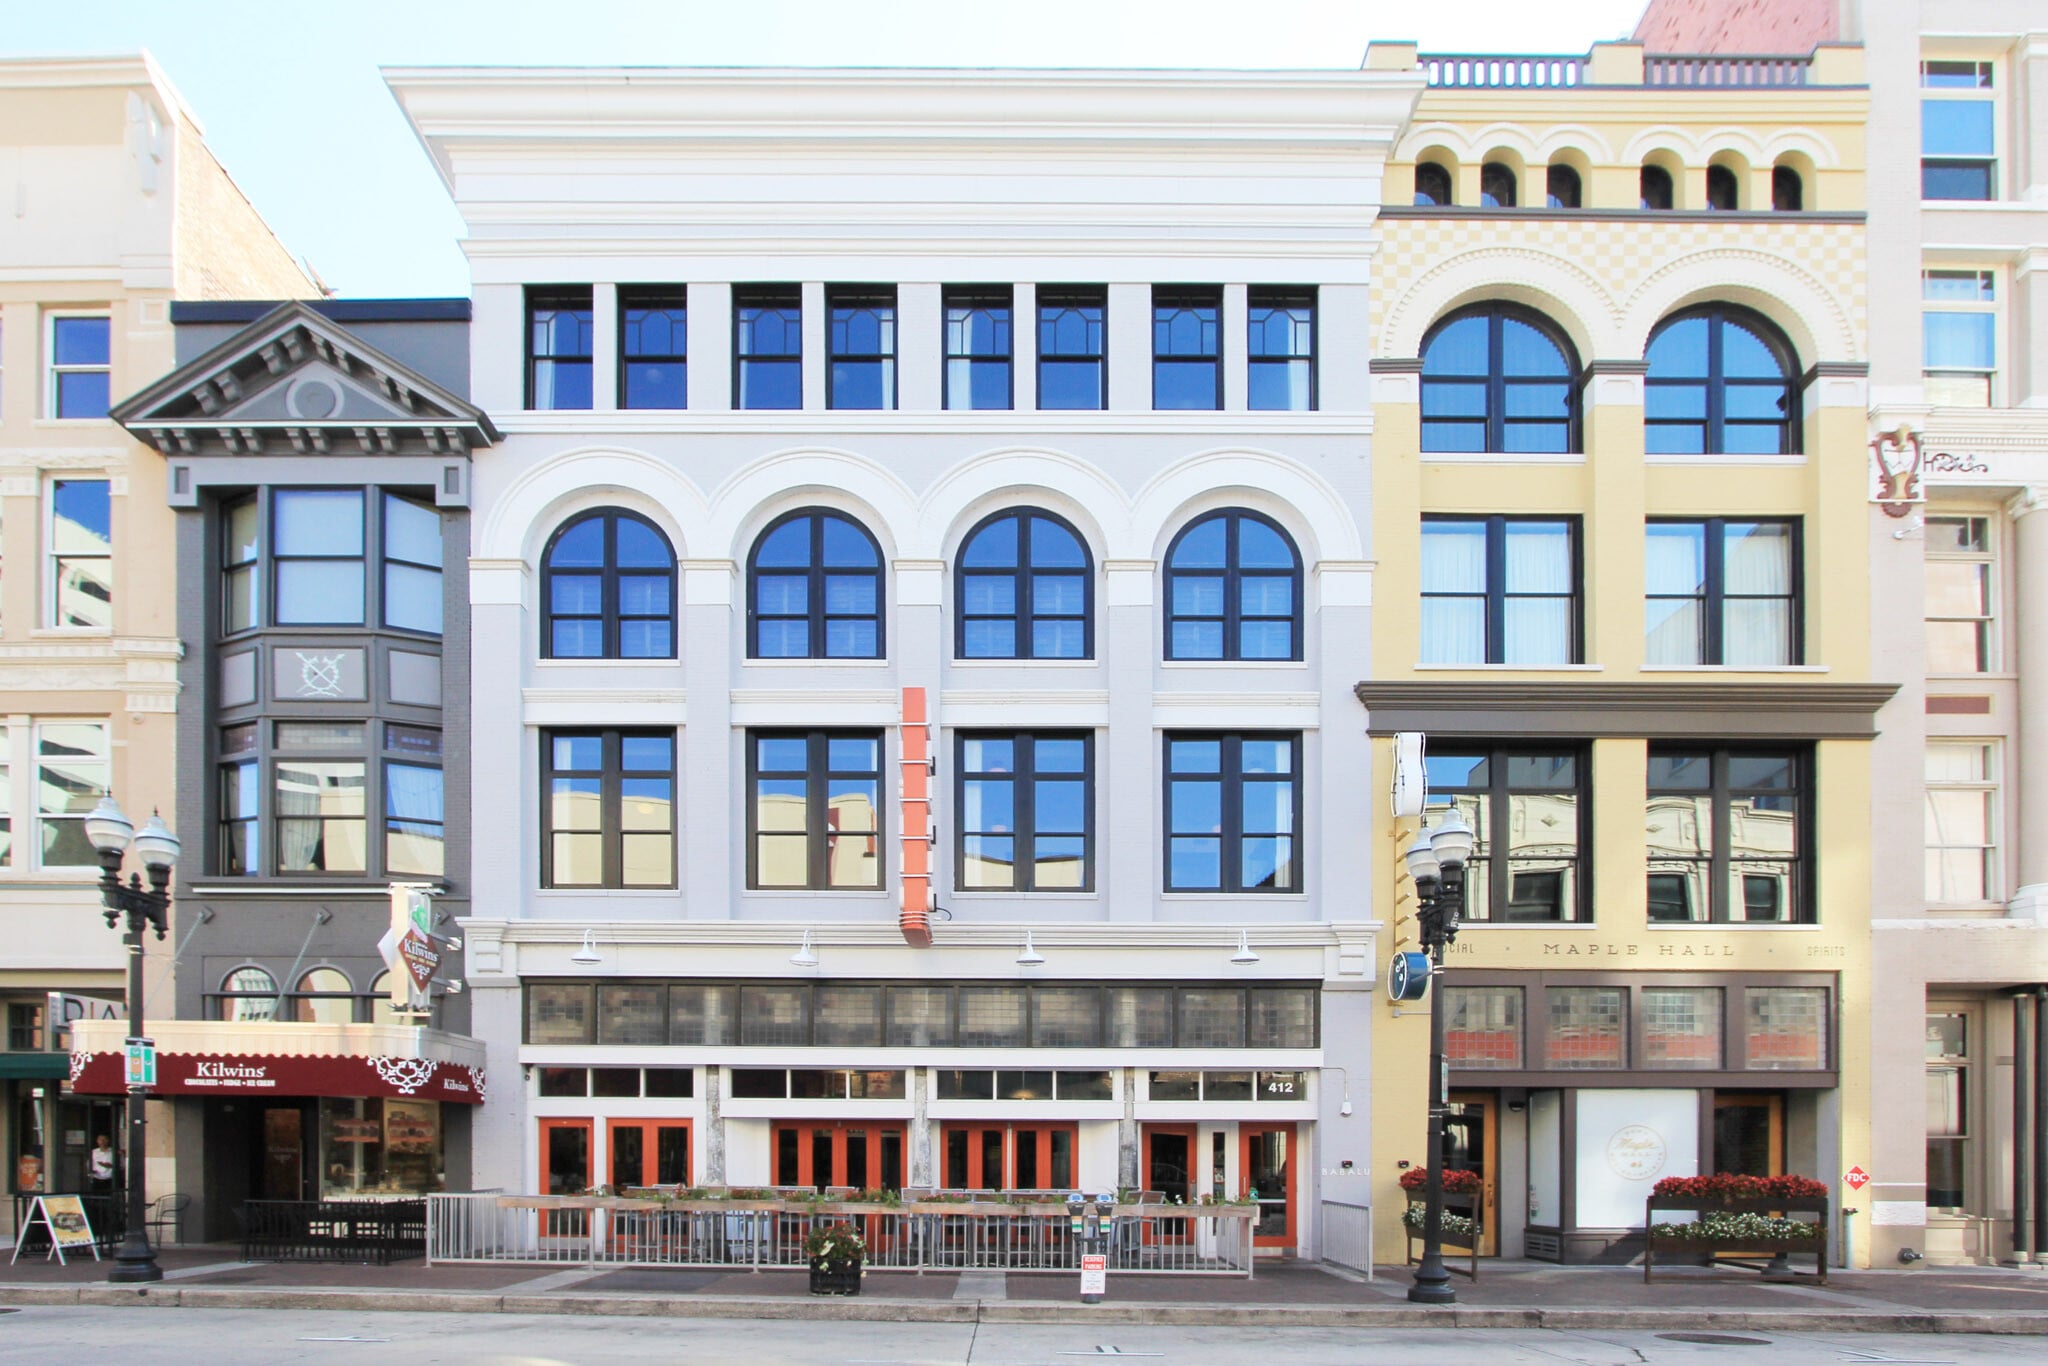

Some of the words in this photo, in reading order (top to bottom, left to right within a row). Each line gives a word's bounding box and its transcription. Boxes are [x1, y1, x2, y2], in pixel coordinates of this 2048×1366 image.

[404, 939, 438, 962] Kilwins
[1543, 943, 1639, 955] MAPLE
[1658, 944, 1735, 956] HALL
[1807, 945, 1846, 957] SPIRITS
[196, 1062, 265, 1078] Kilwins
[443, 1078, 469, 1091] Kilwins
[1268, 1082, 1294, 1093] 412
[1321, 1168, 1370, 1176] BABALU
[1847, 1173, 1867, 1182] FDC
